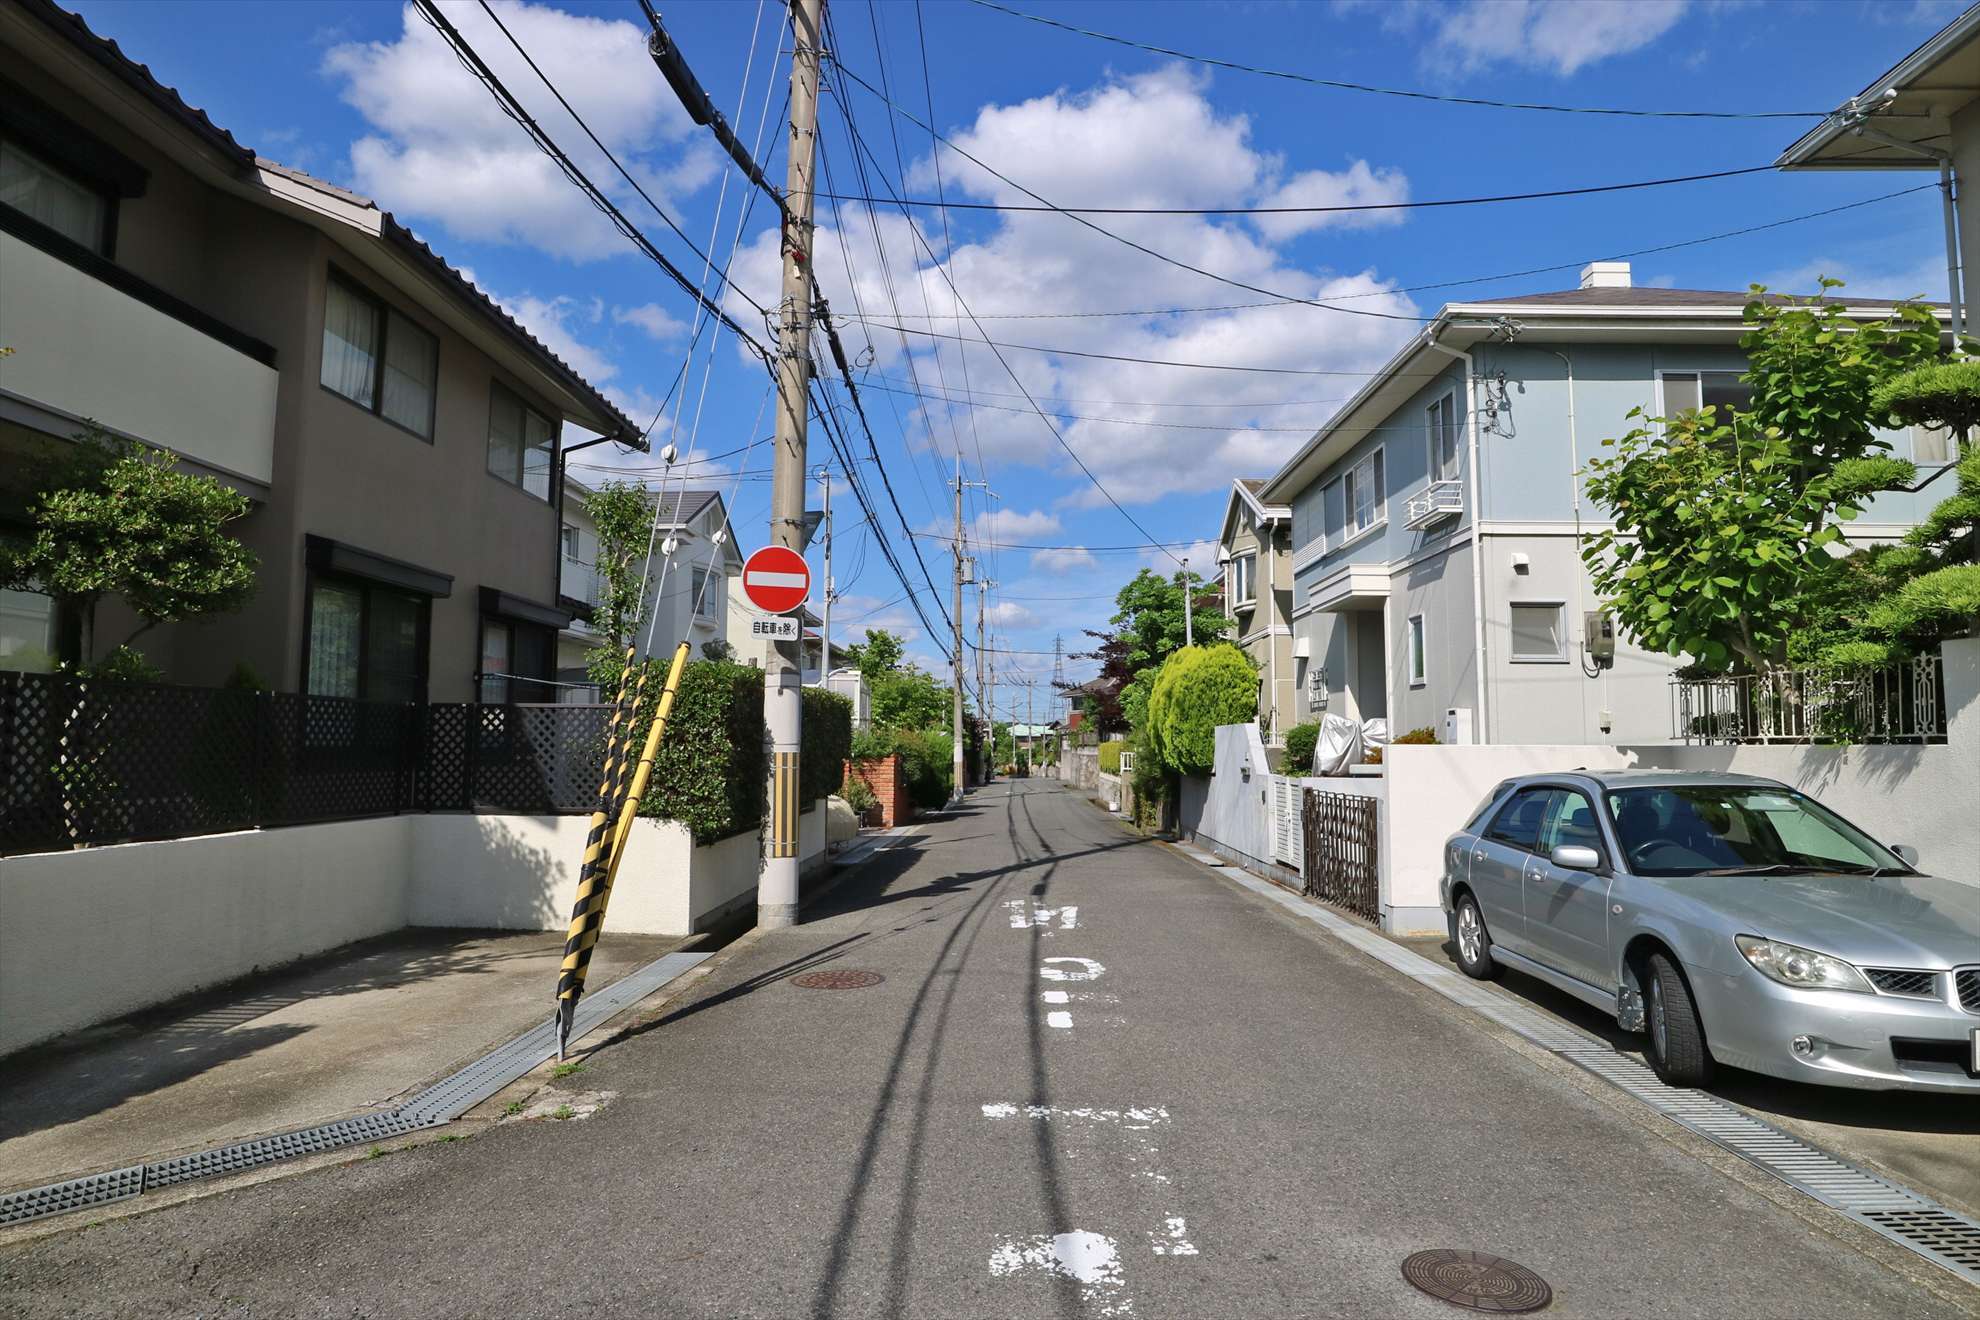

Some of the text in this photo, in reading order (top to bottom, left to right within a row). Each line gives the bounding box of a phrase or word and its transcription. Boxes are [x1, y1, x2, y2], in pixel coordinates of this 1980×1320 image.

[753, 621, 797, 636] 自転車を除く
